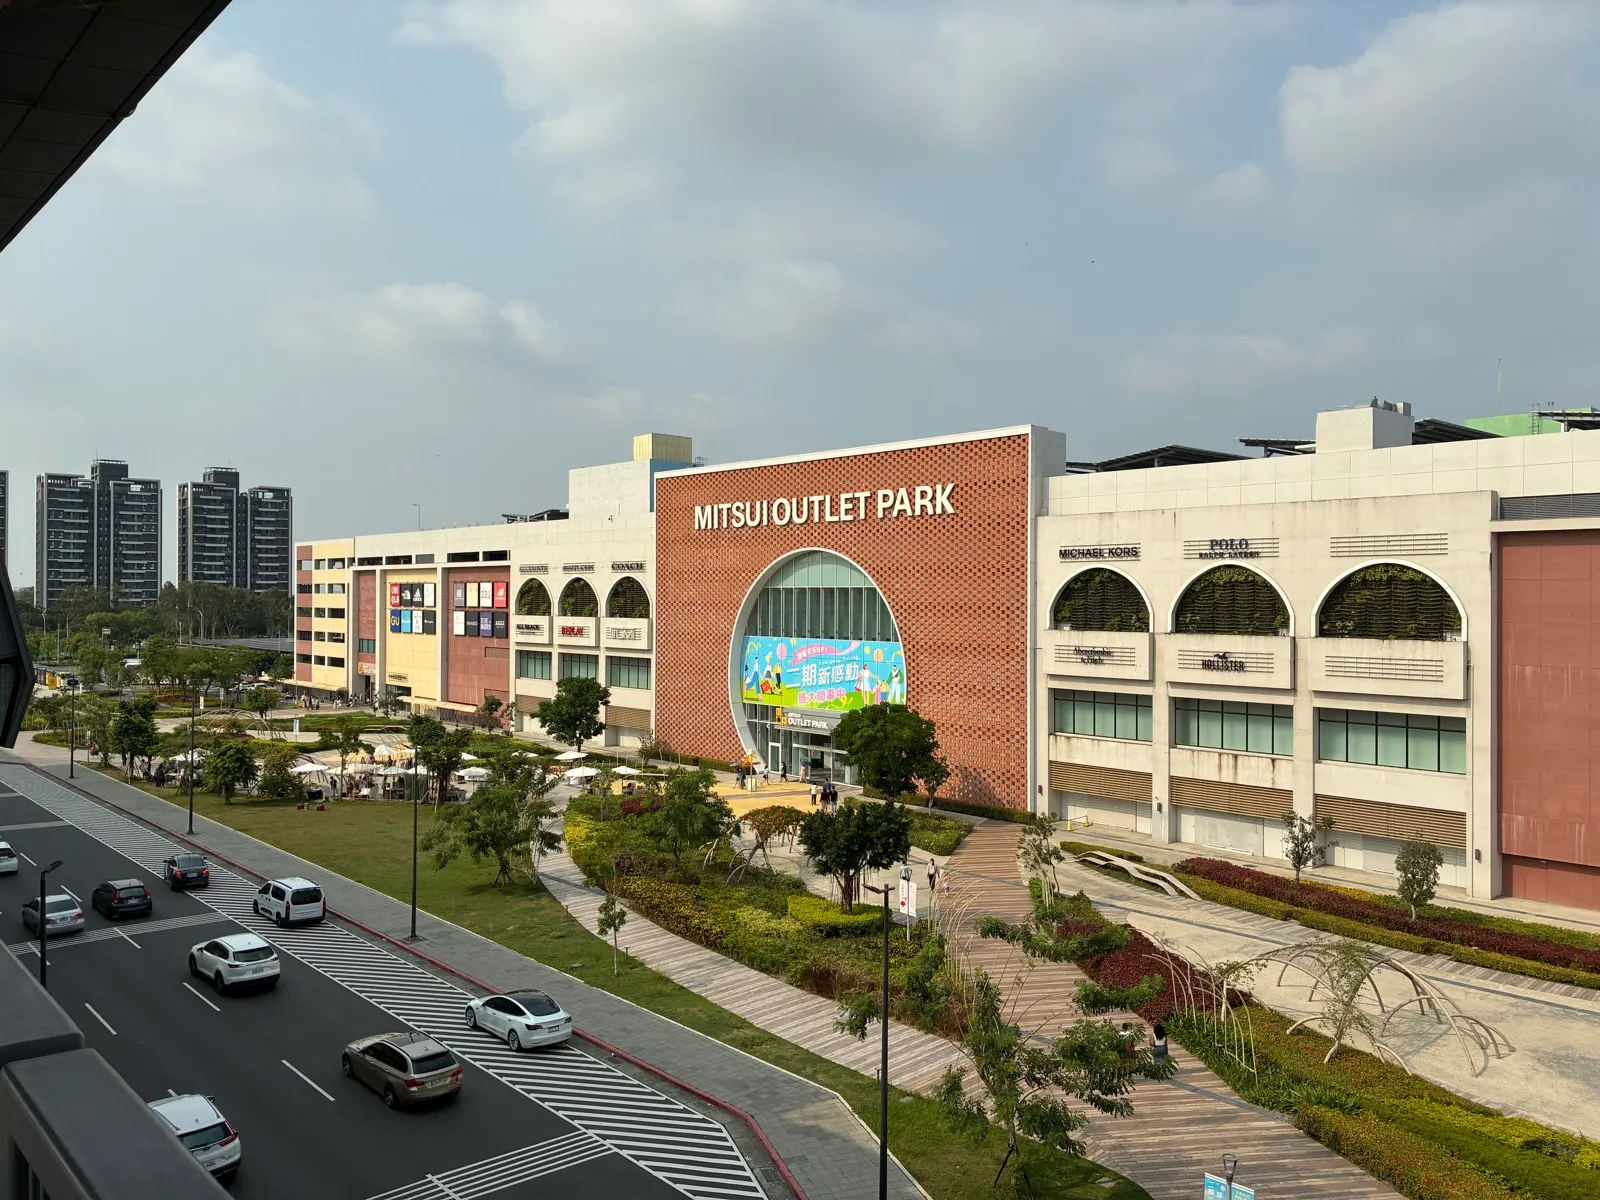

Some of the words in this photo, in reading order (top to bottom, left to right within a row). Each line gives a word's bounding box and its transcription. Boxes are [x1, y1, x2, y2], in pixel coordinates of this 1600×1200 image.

[694, 500, 768, 530] MITSUI
[772, 491, 871, 525] OUTLET
[877, 483, 956, 518] PARK
[1209, 538, 1249, 550] POLO
[1059, 548, 1104, 558] MICHAEL
[1108, 547, 1138, 557] KORS
[1228, 551, 1260, 559] LAUREN
[611, 563, 644, 571] COACH
[391, 616, 399, 626] GU
[1202, 659, 1245, 671] HOLLISTER
[785, 662, 859, 687] 二期新感動
[788, 718, 811, 727] OUTLET
[812, 720, 829, 729] PARK
